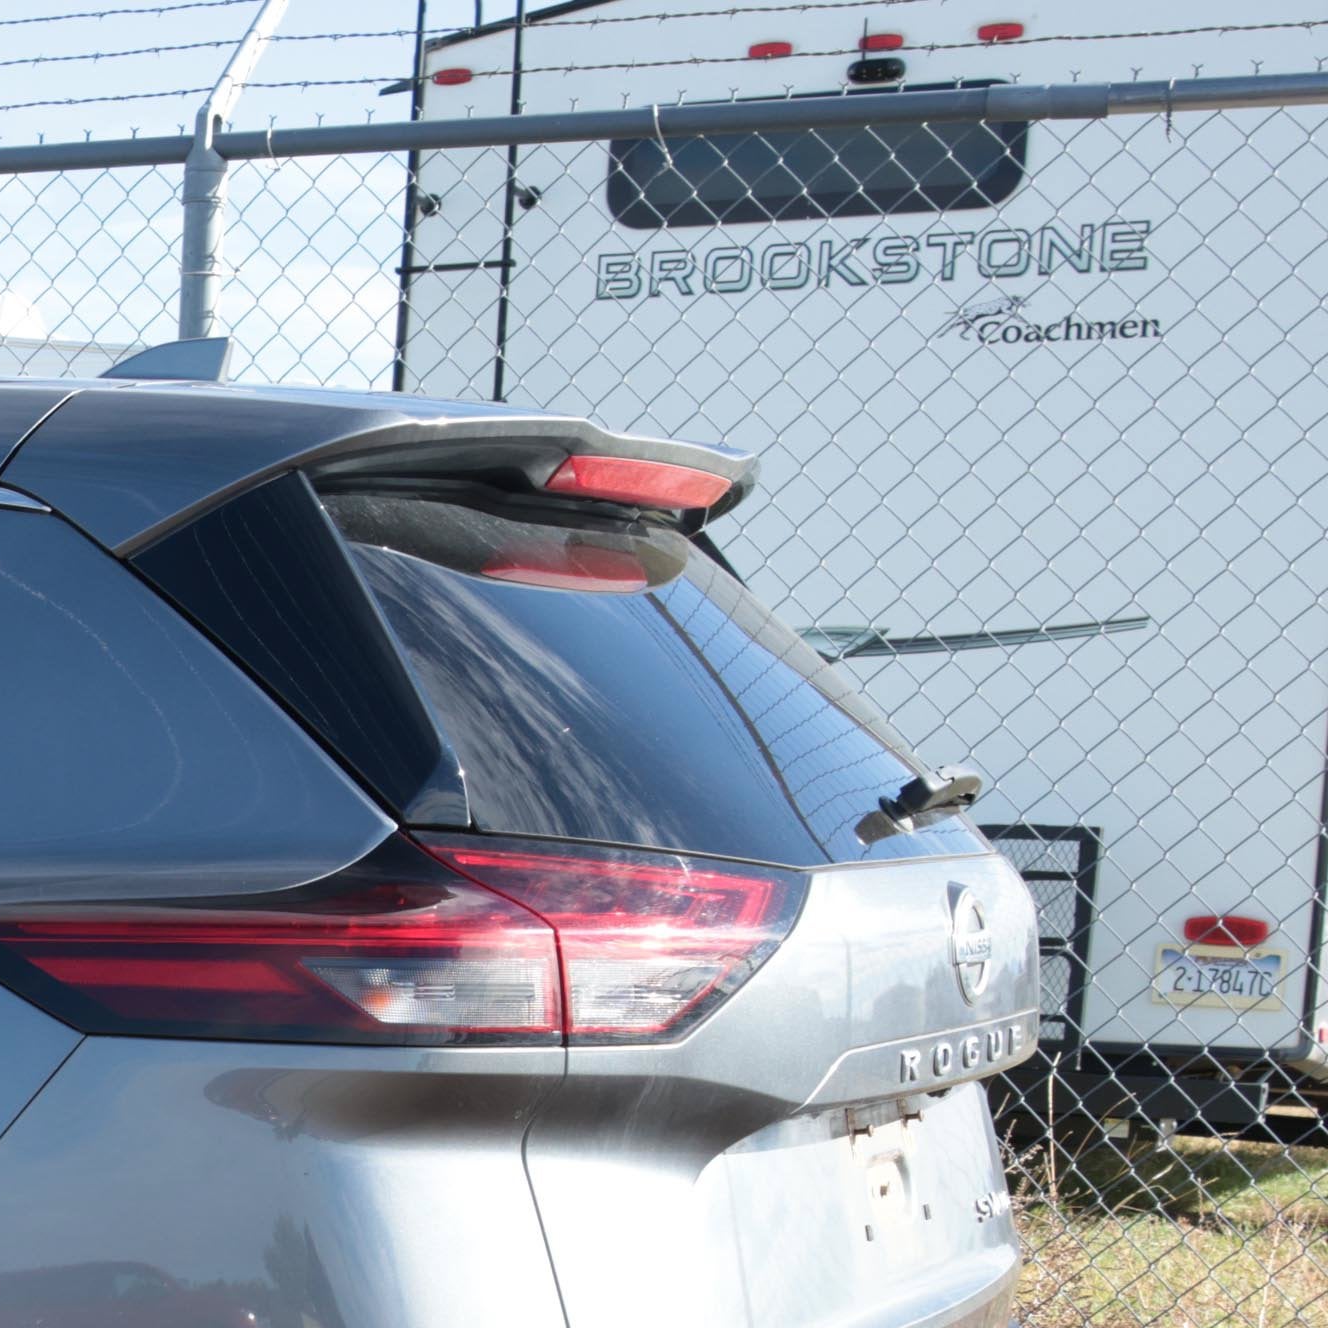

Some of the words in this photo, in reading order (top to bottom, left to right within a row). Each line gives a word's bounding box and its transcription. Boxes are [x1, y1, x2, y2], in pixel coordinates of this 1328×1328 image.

[595, 220, 1152, 300] BROOKSTONE
[977, 315, 1163, 345] Coachmen
[900, 1024, 1024, 1083] ROGUE
